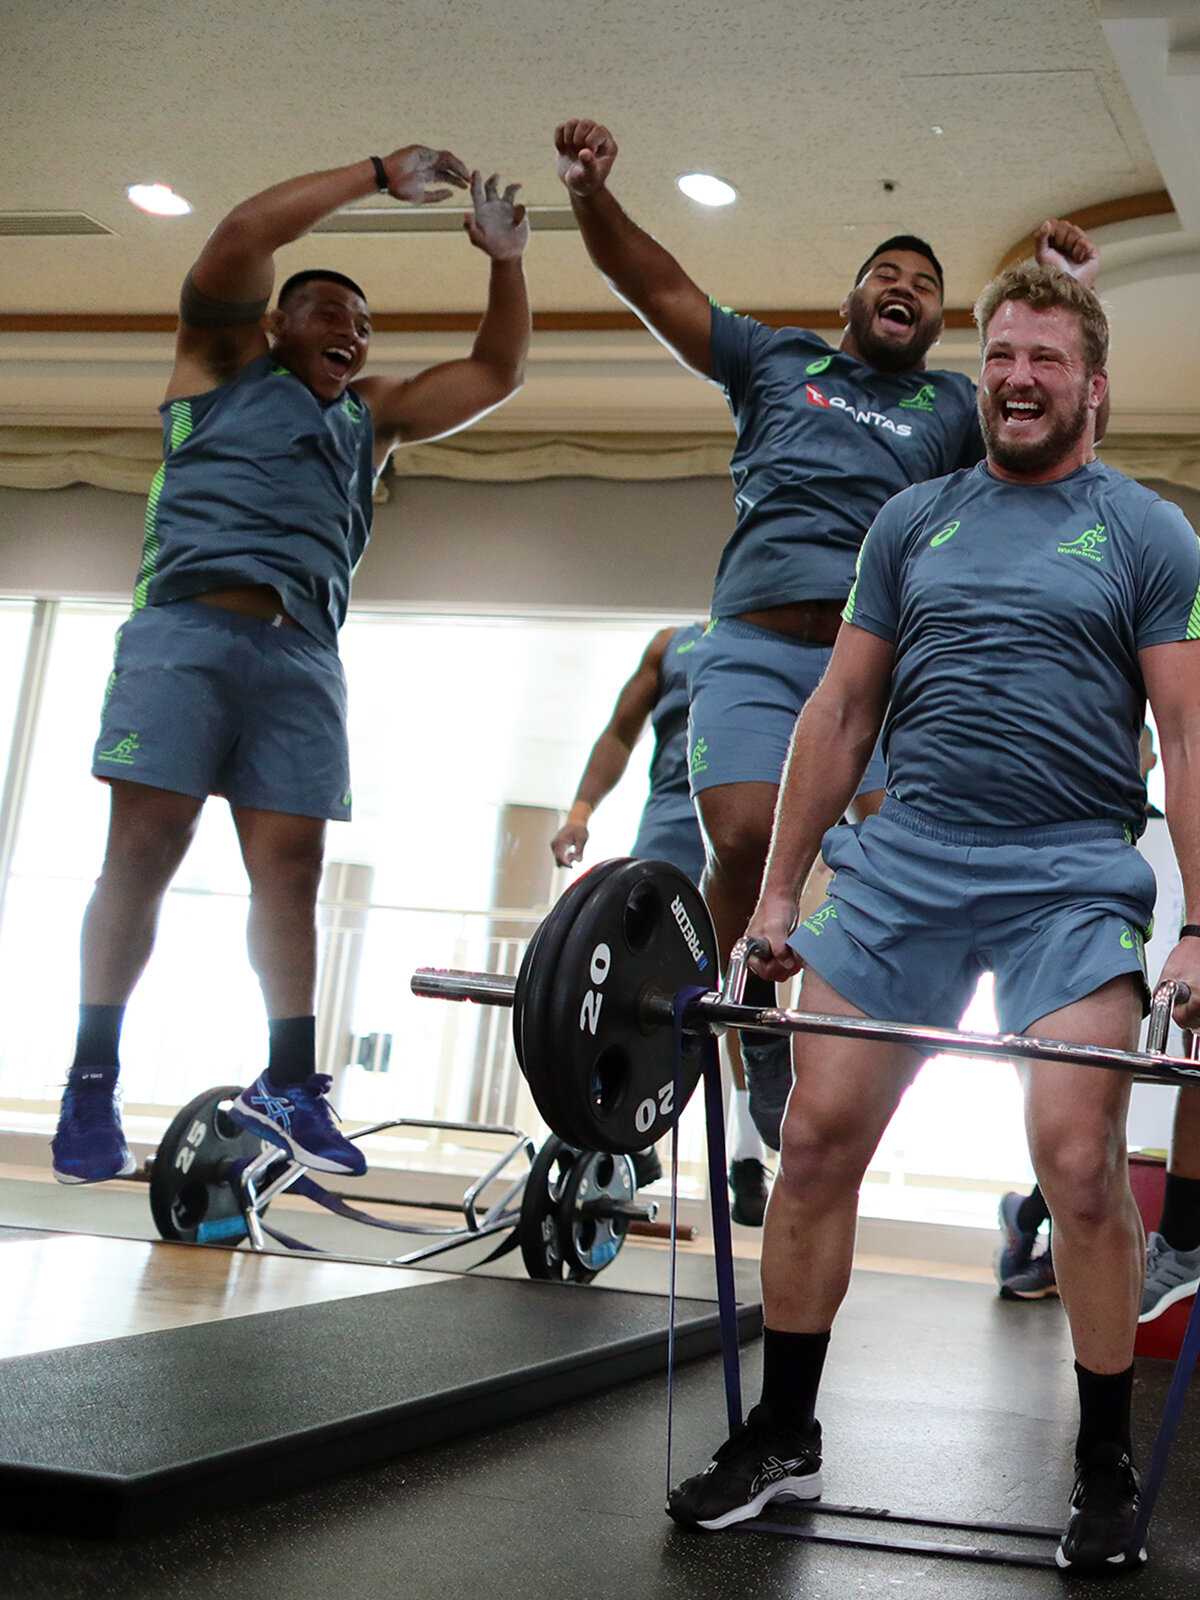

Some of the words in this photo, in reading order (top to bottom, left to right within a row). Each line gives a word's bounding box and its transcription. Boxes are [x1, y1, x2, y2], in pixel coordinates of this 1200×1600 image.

[829, 397, 913, 436] QANTAS
[670, 894, 704, 962] PRECOR
[579, 942, 612, 1036] 20
[635, 1080, 675, 1133] 20
[175, 1120, 207, 1174] 25
